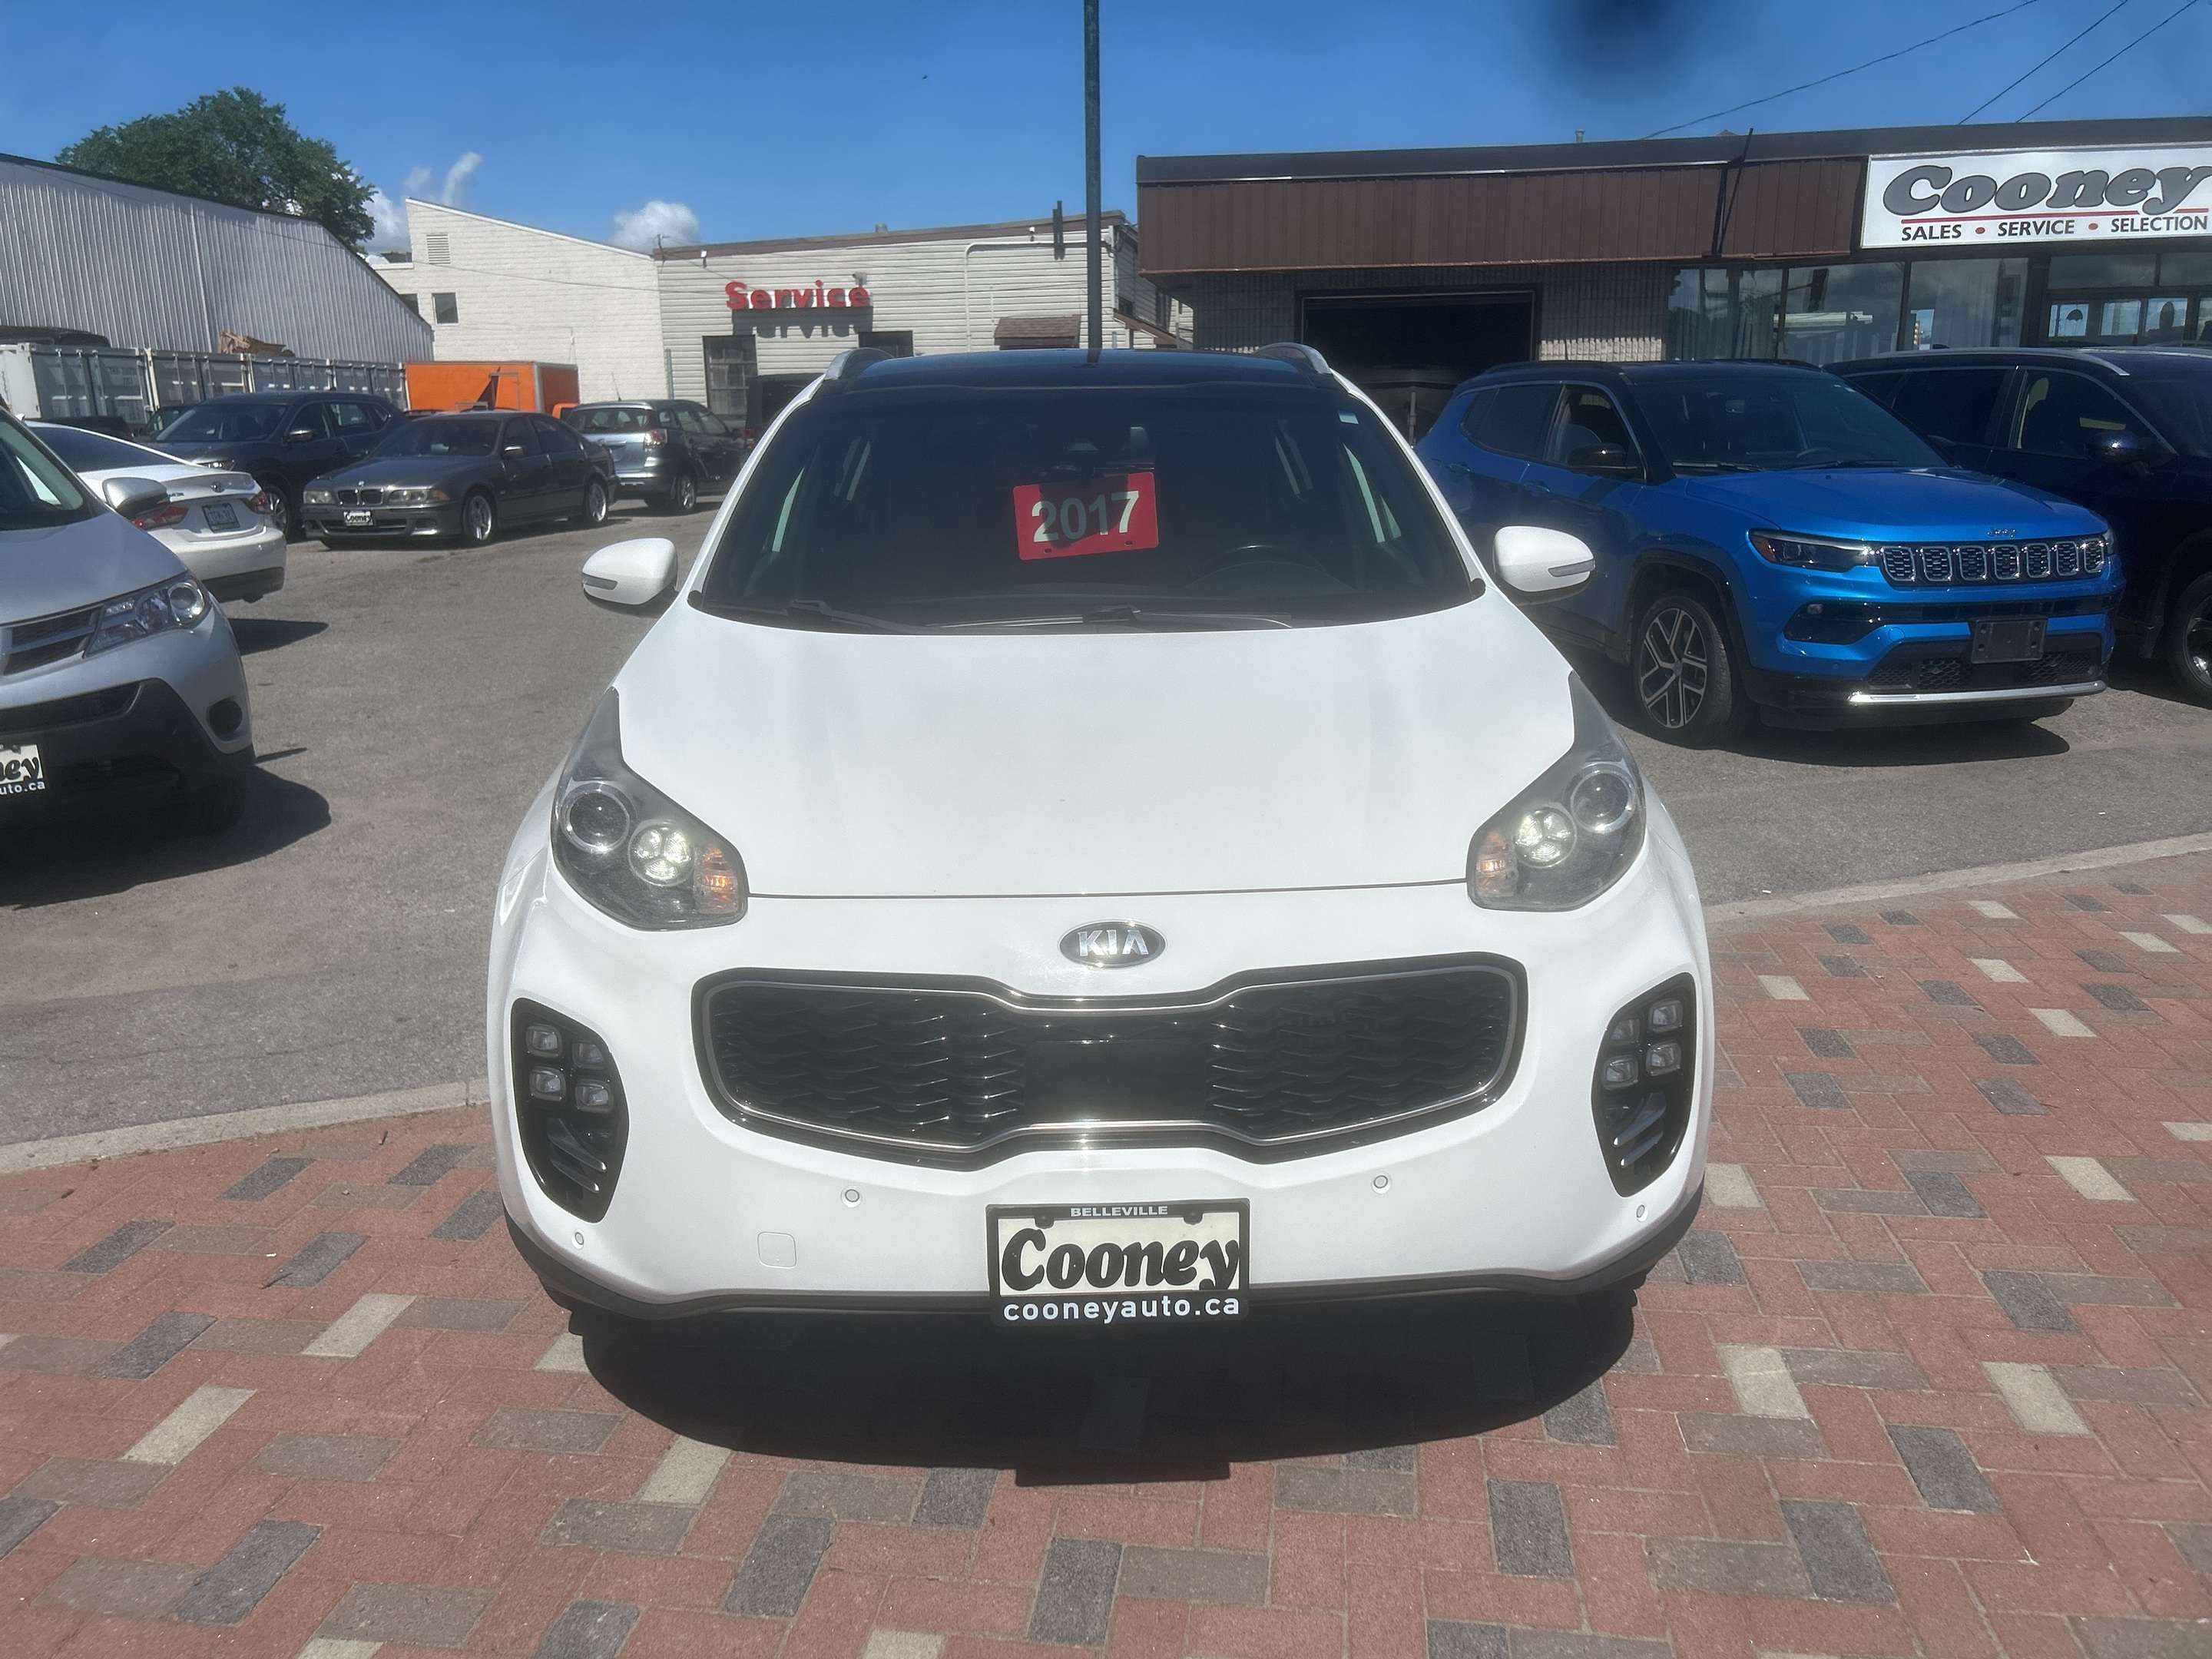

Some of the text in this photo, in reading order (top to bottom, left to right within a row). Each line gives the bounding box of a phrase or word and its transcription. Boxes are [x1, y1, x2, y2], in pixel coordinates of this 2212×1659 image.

[1883, 164, 2212, 216] Cooney
[1901, 215, 2208, 241] SALES SERVICE SELECTION
[724, 280, 872, 310] Service
[1031, 490, 1139, 542] 2017
[1078, 929, 1149, 957] KIA
[1070, 1205, 1168, 1217] BELLEVILLE
[1002, 1227, 1240, 1291] Cooney
[1003, 1295, 1240, 1324] cooneyauto.ca
